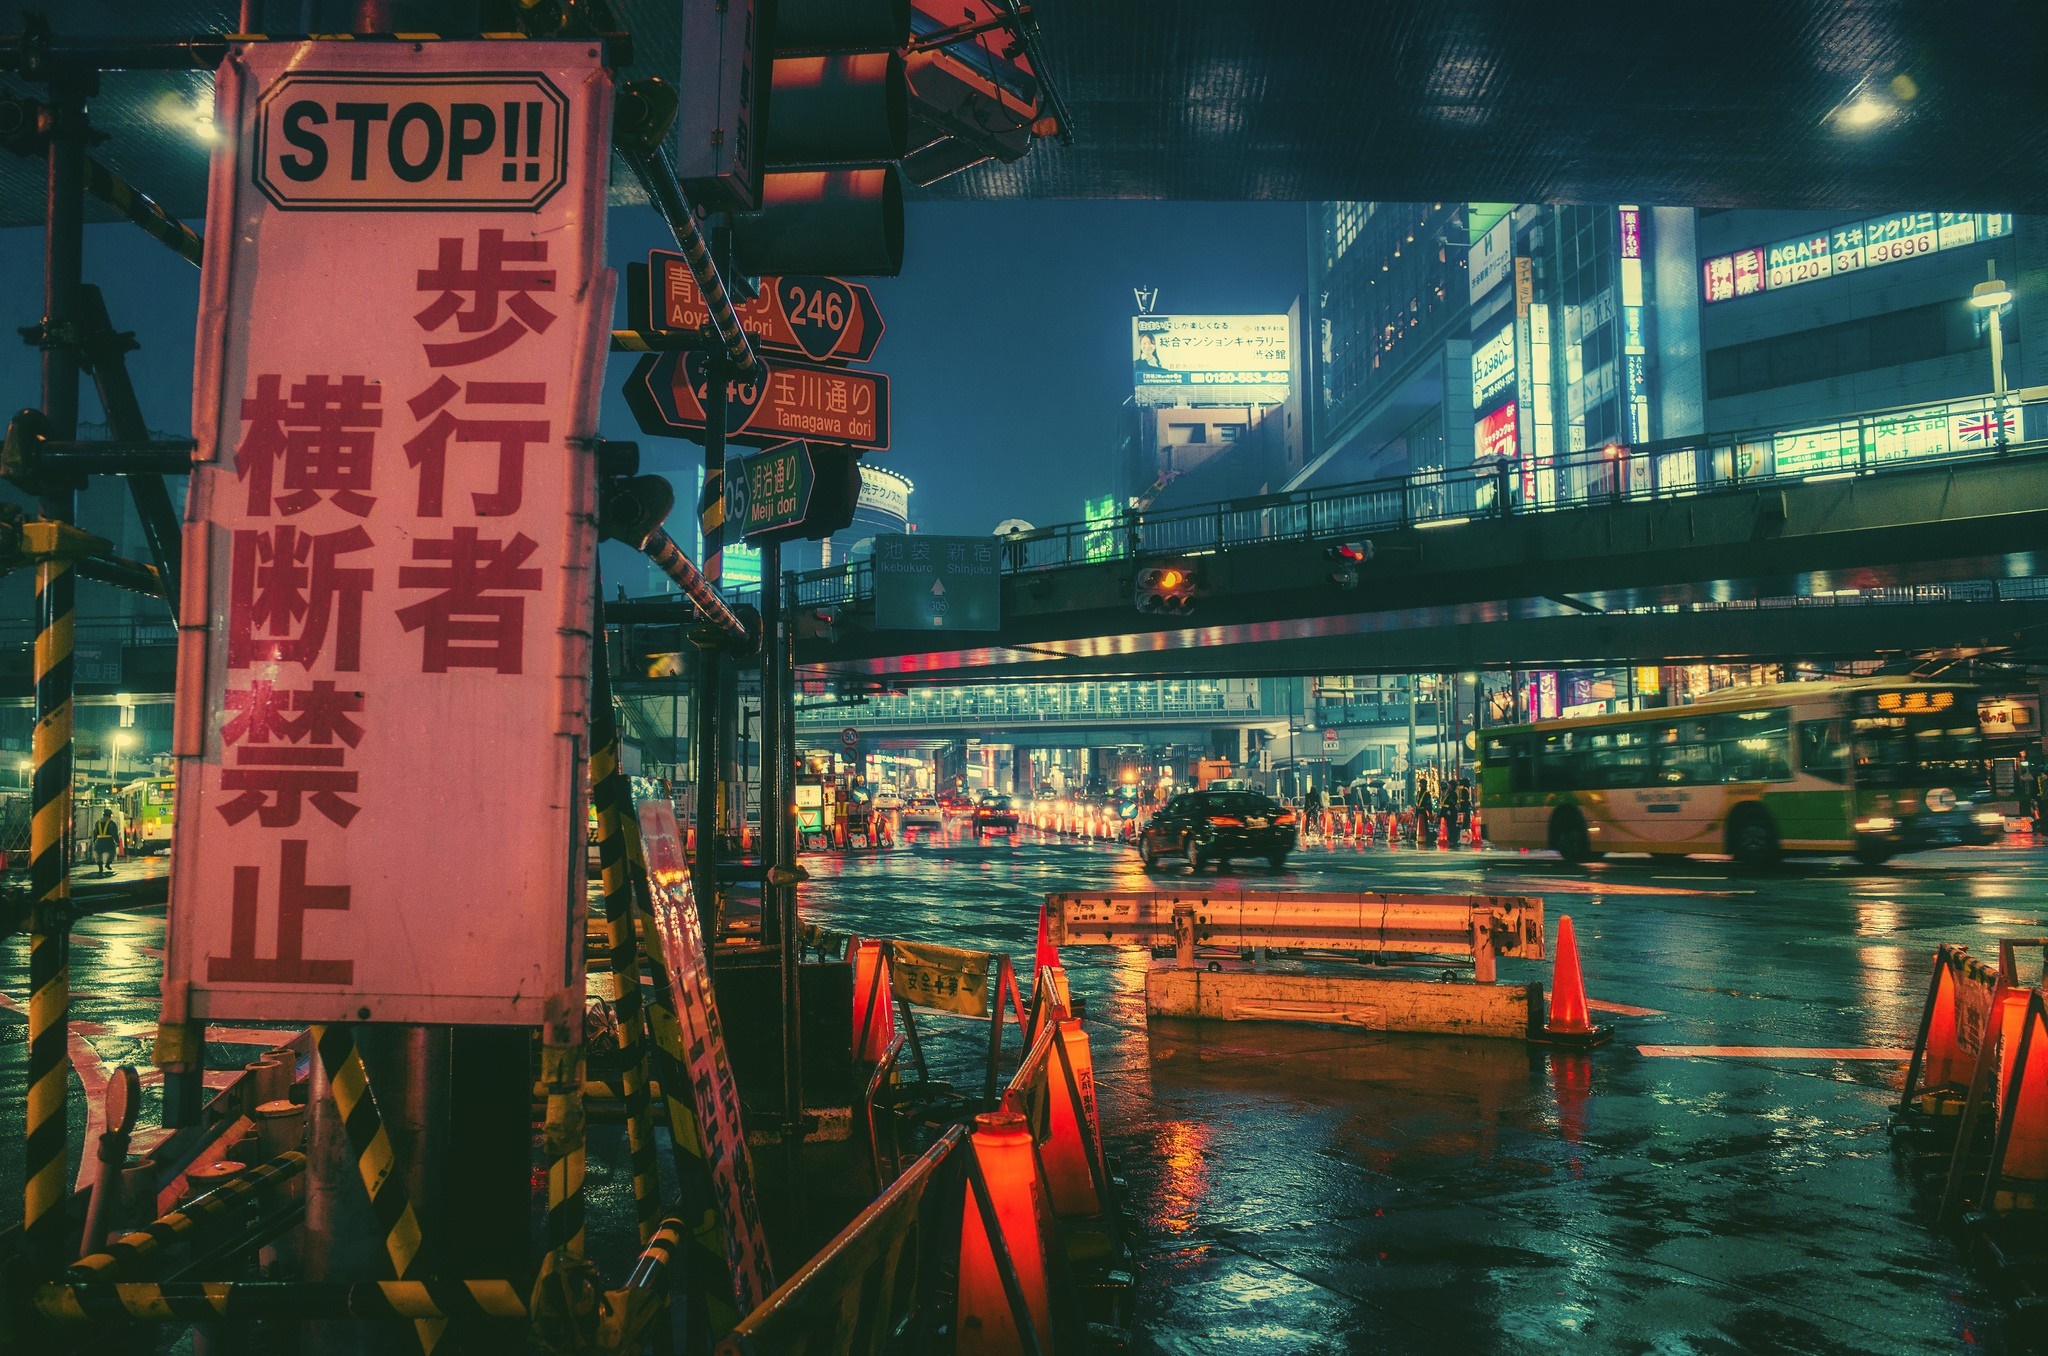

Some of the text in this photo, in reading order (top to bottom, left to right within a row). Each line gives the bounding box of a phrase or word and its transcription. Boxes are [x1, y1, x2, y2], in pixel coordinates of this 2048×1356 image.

[279, 100, 544, 184] STOP!!
[1769, 242, 1811, 266] AGA
[1773, 236, 1930, 287] 0120-31-9696
[789, 286, 844, 331] 246
[743, 315, 773, 337] dori
[774, 372, 872, 416] 玉川通り
[775, 408, 872, 437] Tamagawa dori
[1878, 409, 1947, 439] 英会話
[394, 228, 558, 675] 歩行者
[1825, 450, 1839, 458] FOR
[1928, 444, 1943, 454] 4F
[752, 455, 798, 501] 明治通り
[725, 476, 744, 522] 05
[752, 491, 797, 522] Meiji dori
[884, 542, 993, 562] 池袋 新宿
[881, 562, 993, 576] Ikebukuro Shinjuku
[930, 601, 946, 611] 305
[207, 373, 384, 986] 横断禁止
[844, 732, 855, 741] 50
